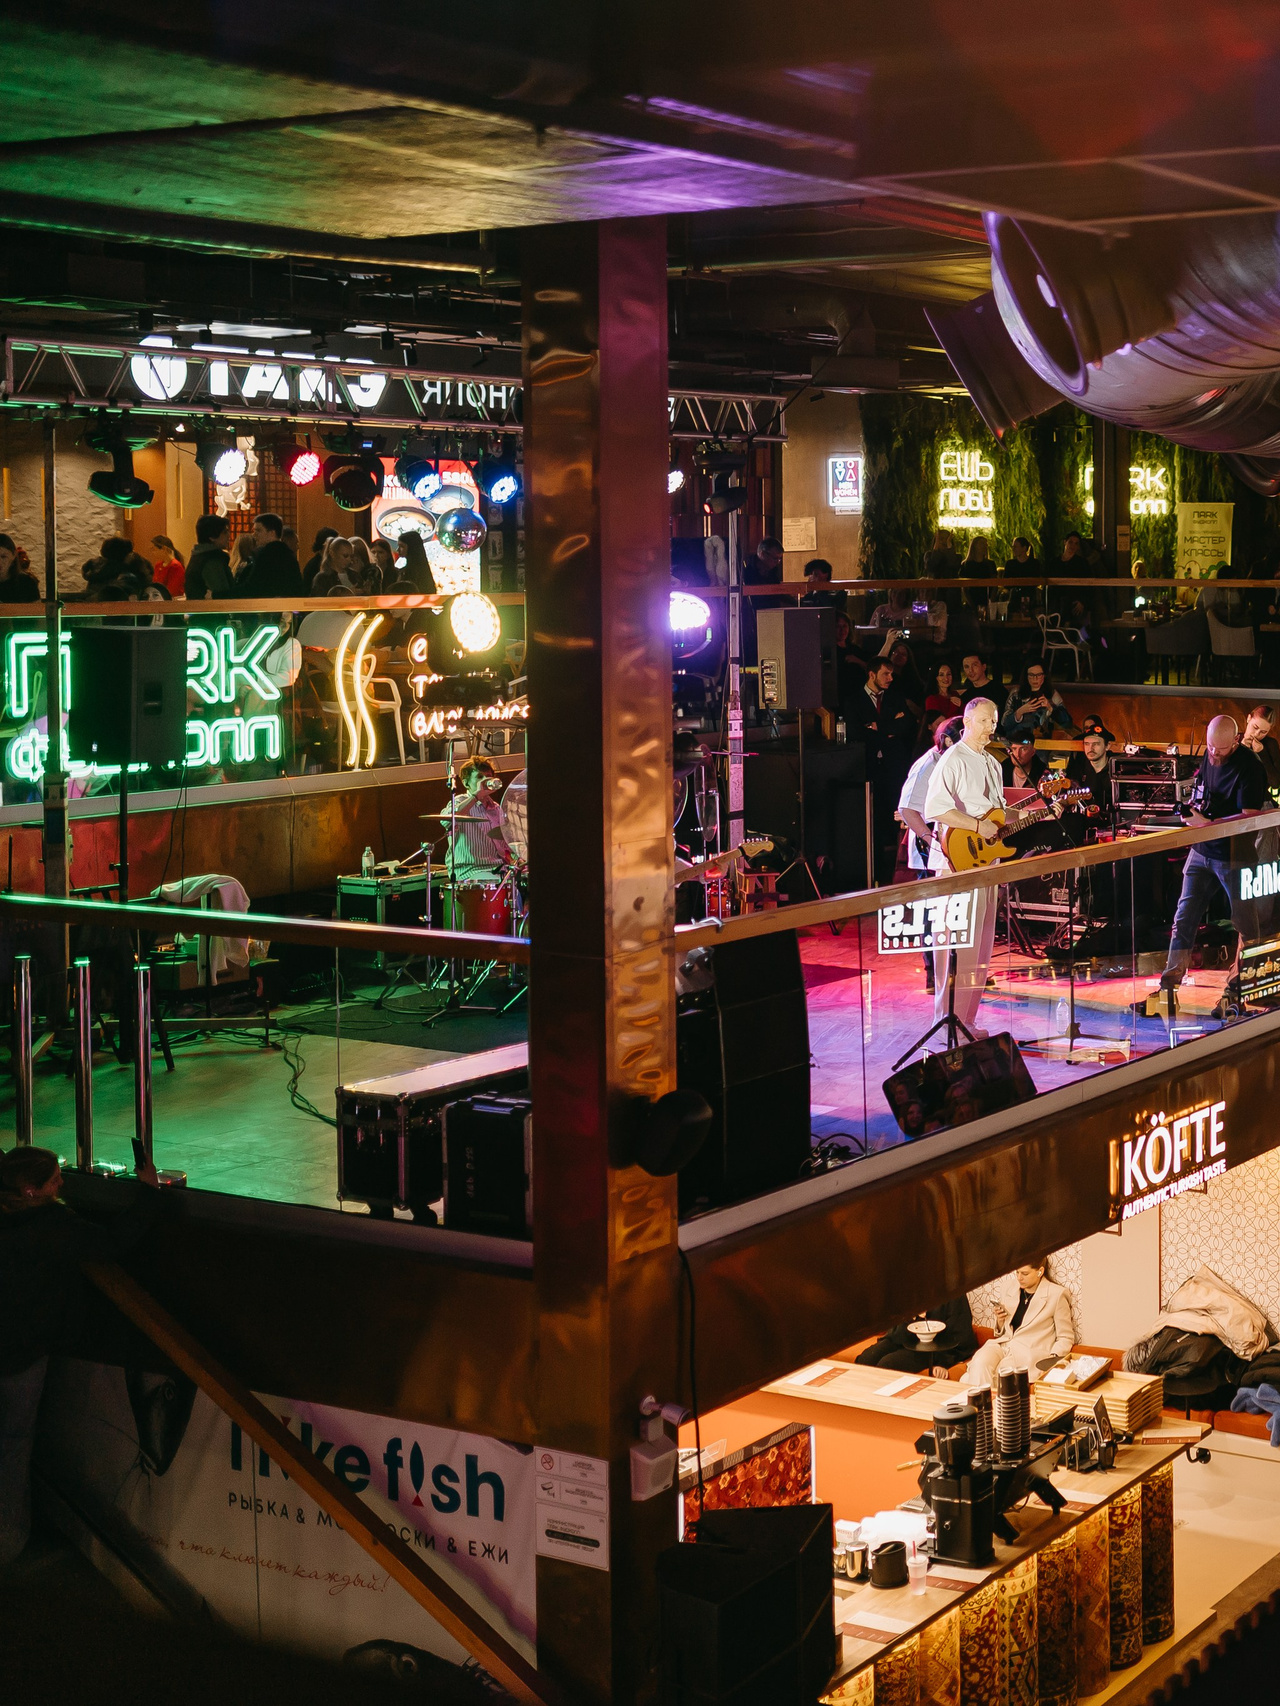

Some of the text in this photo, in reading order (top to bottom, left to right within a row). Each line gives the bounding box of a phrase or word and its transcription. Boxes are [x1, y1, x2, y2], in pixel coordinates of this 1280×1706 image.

[940, 451, 994, 481] ЕШЬ
[1183, 549, 1226, 557] КЛАССЫ
[1184, 536, 1226, 545] МАСТЕР
[1122, 1100, 1226, 1197] KÖFTE
[1122, 1158, 1227, 1220] AUTHENTIC TURKISH TASTE
[228, 1492, 289, 1521] РЫБКА
[296, 1508, 306, 1524] &
[447, 1538, 458, 1554] &
[468, 1540, 509, 1565] ЕЖИ
